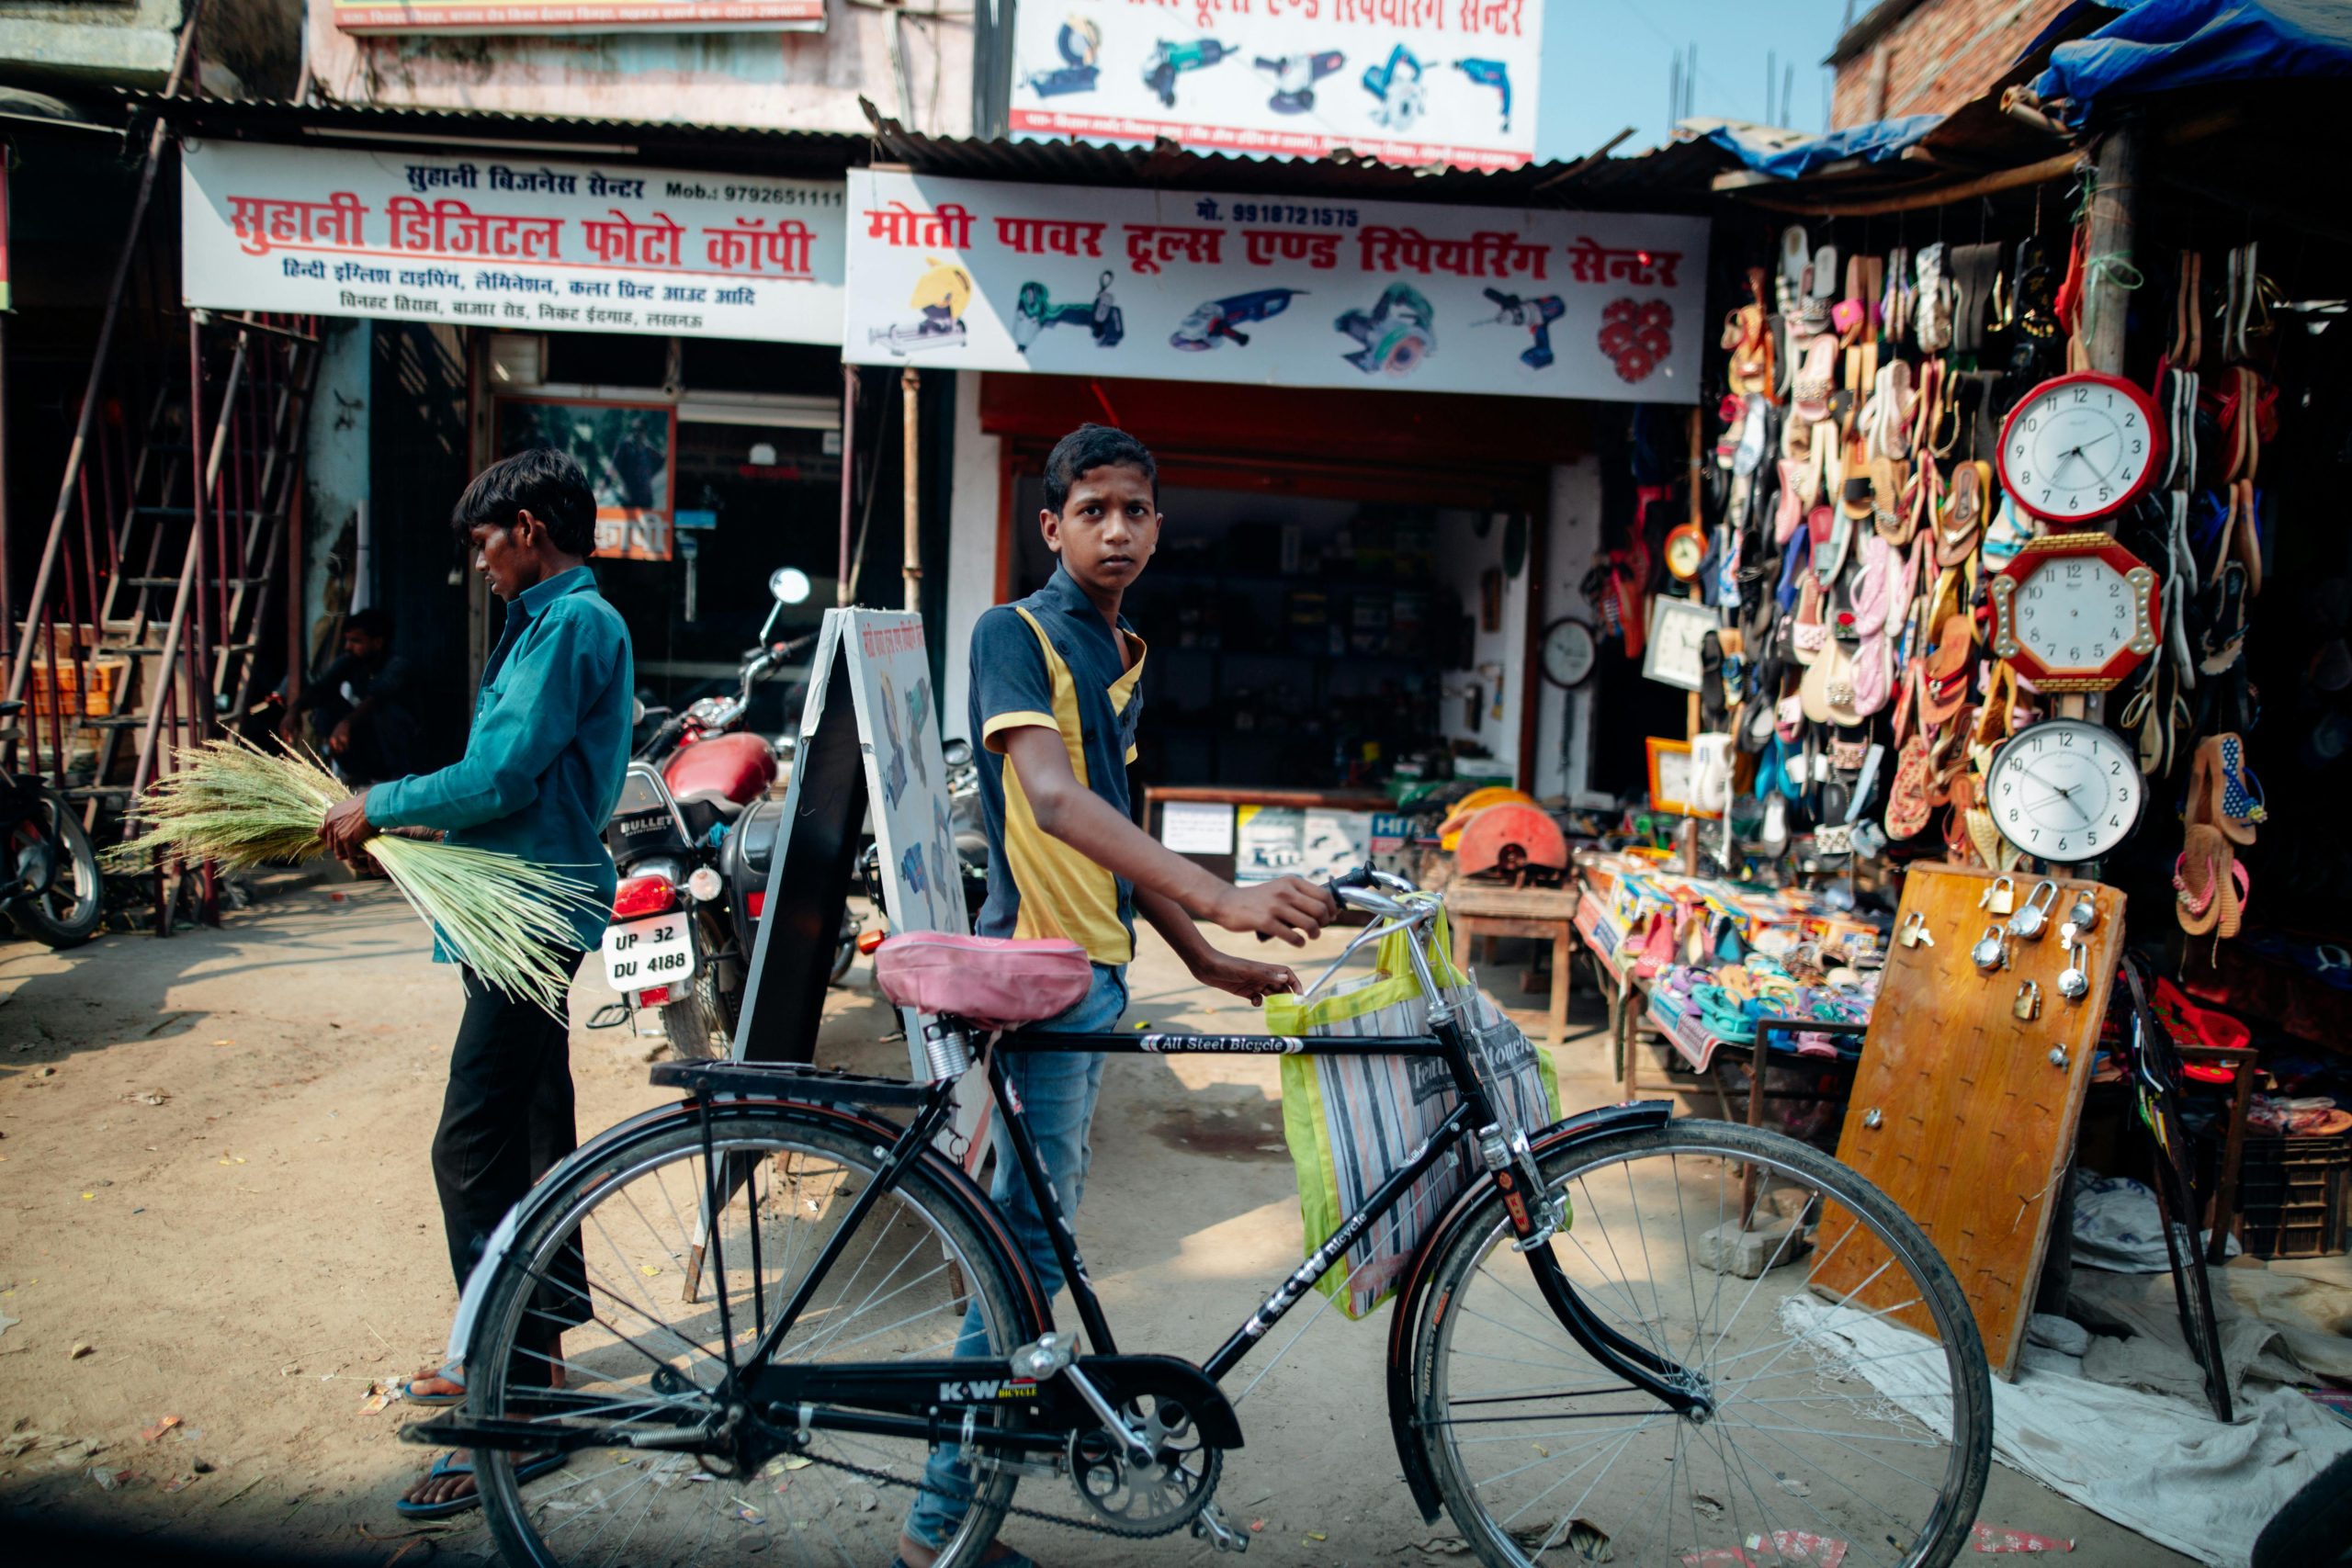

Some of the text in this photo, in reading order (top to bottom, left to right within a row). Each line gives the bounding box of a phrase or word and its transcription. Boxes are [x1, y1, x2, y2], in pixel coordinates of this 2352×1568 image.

[405, 164, 646, 199] सुहानी बिजनेस सेन्टर
[227, 192, 817, 274] सुहानी डिजिटल फोटो कॉपी
[864, 200, 1683, 288] मोती पावर टूल्स एण्ड रिपेयरिंग सेन्टर
[282, 257, 326, 279] हिन्दी
[569, 279, 610, 299] कलर
[662, 285, 707, 303] आउट
[715, 287, 756, 306] आदि
[2073, 389, 2087, 402] 12
[2108, 394, 2113, 408] 1
[2046, 398, 2057, 411] 11
[2022, 418, 2037, 432] 10
[2125, 413, 2135, 427] 2
[2016, 445, 2025, 458] 9
[2132, 440, 2142, 454] 3
[2021, 471, 2030, 484] 8
[2121, 468, 2132, 481] 4
[2041, 490, 2052, 503] 7
[2069, 495, 2078, 509] 6
[2098, 488, 2109, 502] 5
[2045, 570, 2055, 582] 11
[2065, 564, 2082, 579] 12
[2095, 567, 2101, 581] 1
[2029, 587, 2043, 600] 10
[2109, 584, 2120, 598] 2
[2024, 606, 2034, 620] 9
[2115, 604, 2125, 619] 3
[2030, 628, 2041, 643] 8
[2109, 626, 2120, 640] 4
[2046, 643, 2056, 658] 7
[2070, 647, 2080, 660] 6
[2094, 644, 2104, 658] 5
[2030, 739, 2042, 752] 11
[2058, 732, 2073, 747] 12
[2093, 740, 2098, 755] 1
[2007, 757, 2023, 772] 10
[2111, 761, 2121, 775] 2
[2003, 783, 2011, 795] 9
[2119, 787, 2129, 802] 3
[2009, 808, 2018, 822] 8
[2109, 815, 2120, 828] 4
[620, 815, 674, 834] BULLET
[2030, 829, 2040, 842] 7
[2087, 831, 2097, 846] 5
[2058, 837, 2067, 851] 6
[615, 926, 674, 951] UP 32
[614, 953, 686, 978] DU 4188
[1161, 1035, 1283, 1054] All Steel Bicycle
[1324, 1213, 1368, 1257] Bicycle
[998, 1387, 1037, 1399] BICYCLE
